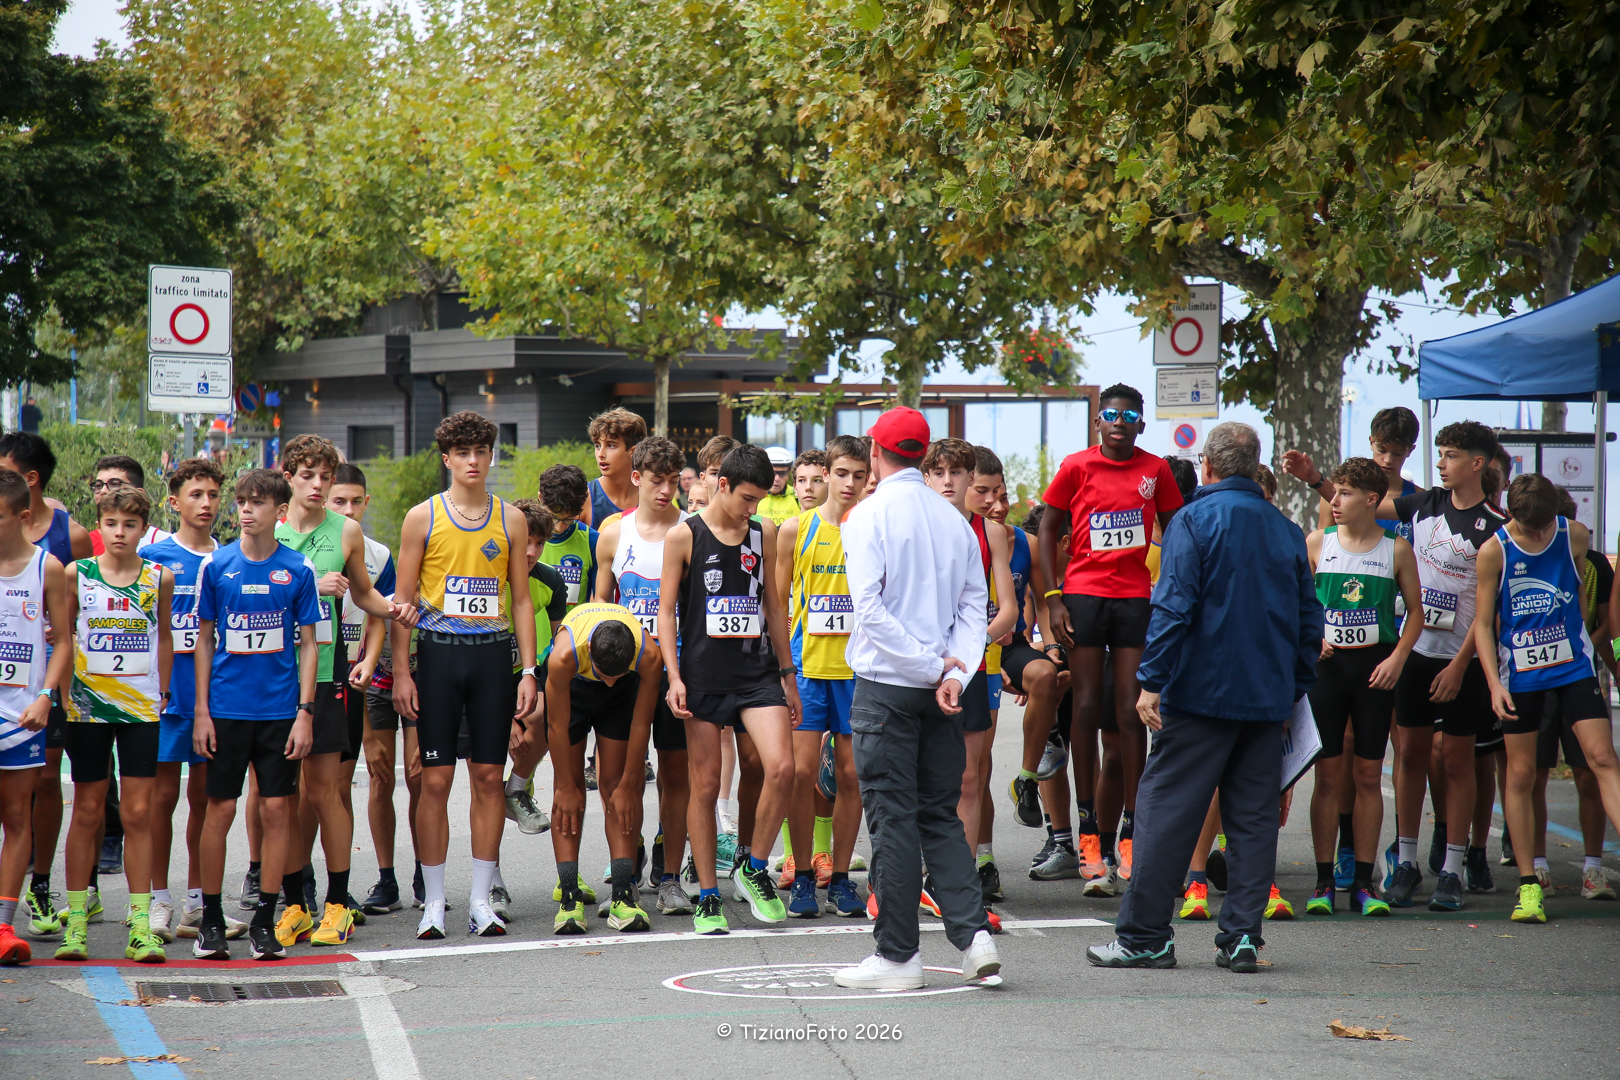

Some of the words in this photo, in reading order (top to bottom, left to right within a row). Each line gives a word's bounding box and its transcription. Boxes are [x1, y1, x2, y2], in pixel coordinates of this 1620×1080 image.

[181, 275, 200, 284] zona
[155, 285, 188, 296] traffico
[193, 287, 228, 298] limitato
[1188, 302, 1217, 311] limitato
[1113, 510, 1141, 518] CENTRO
[1102, 529, 1134, 547] 219
[812, 565, 824, 573] ASD
[6, 589, 30, 597] AVIS
[1428, 591, 1456, 600] CENTRO
[1511, 593, 1550, 603] ATLETICA
[457, 597, 487, 613] 163
[1427, 599, 1454, 608] ITALIANO
[1428, 595, 1455, 604] SPORTIVO
[1511, 599, 1551, 610] UNION
[570, 608, 627, 622] CORTENOVA
[88, 618, 148, 630] SAMPOLESE
[719, 616, 750, 632] 387
[825, 614, 844, 630] 41
[1535, 625, 1564, 634] CENTRO
[1535, 629, 1565, 639] SPORTIVO
[184, 632, 199, 647] 5
[243, 633, 266, 649] 17
[1334, 628, 1366, 644] 380
[1536, 633, 1566, 643] ITALIANO
[1527, 644, 1558, 665] 547
[113, 655, 124, 671] 2
